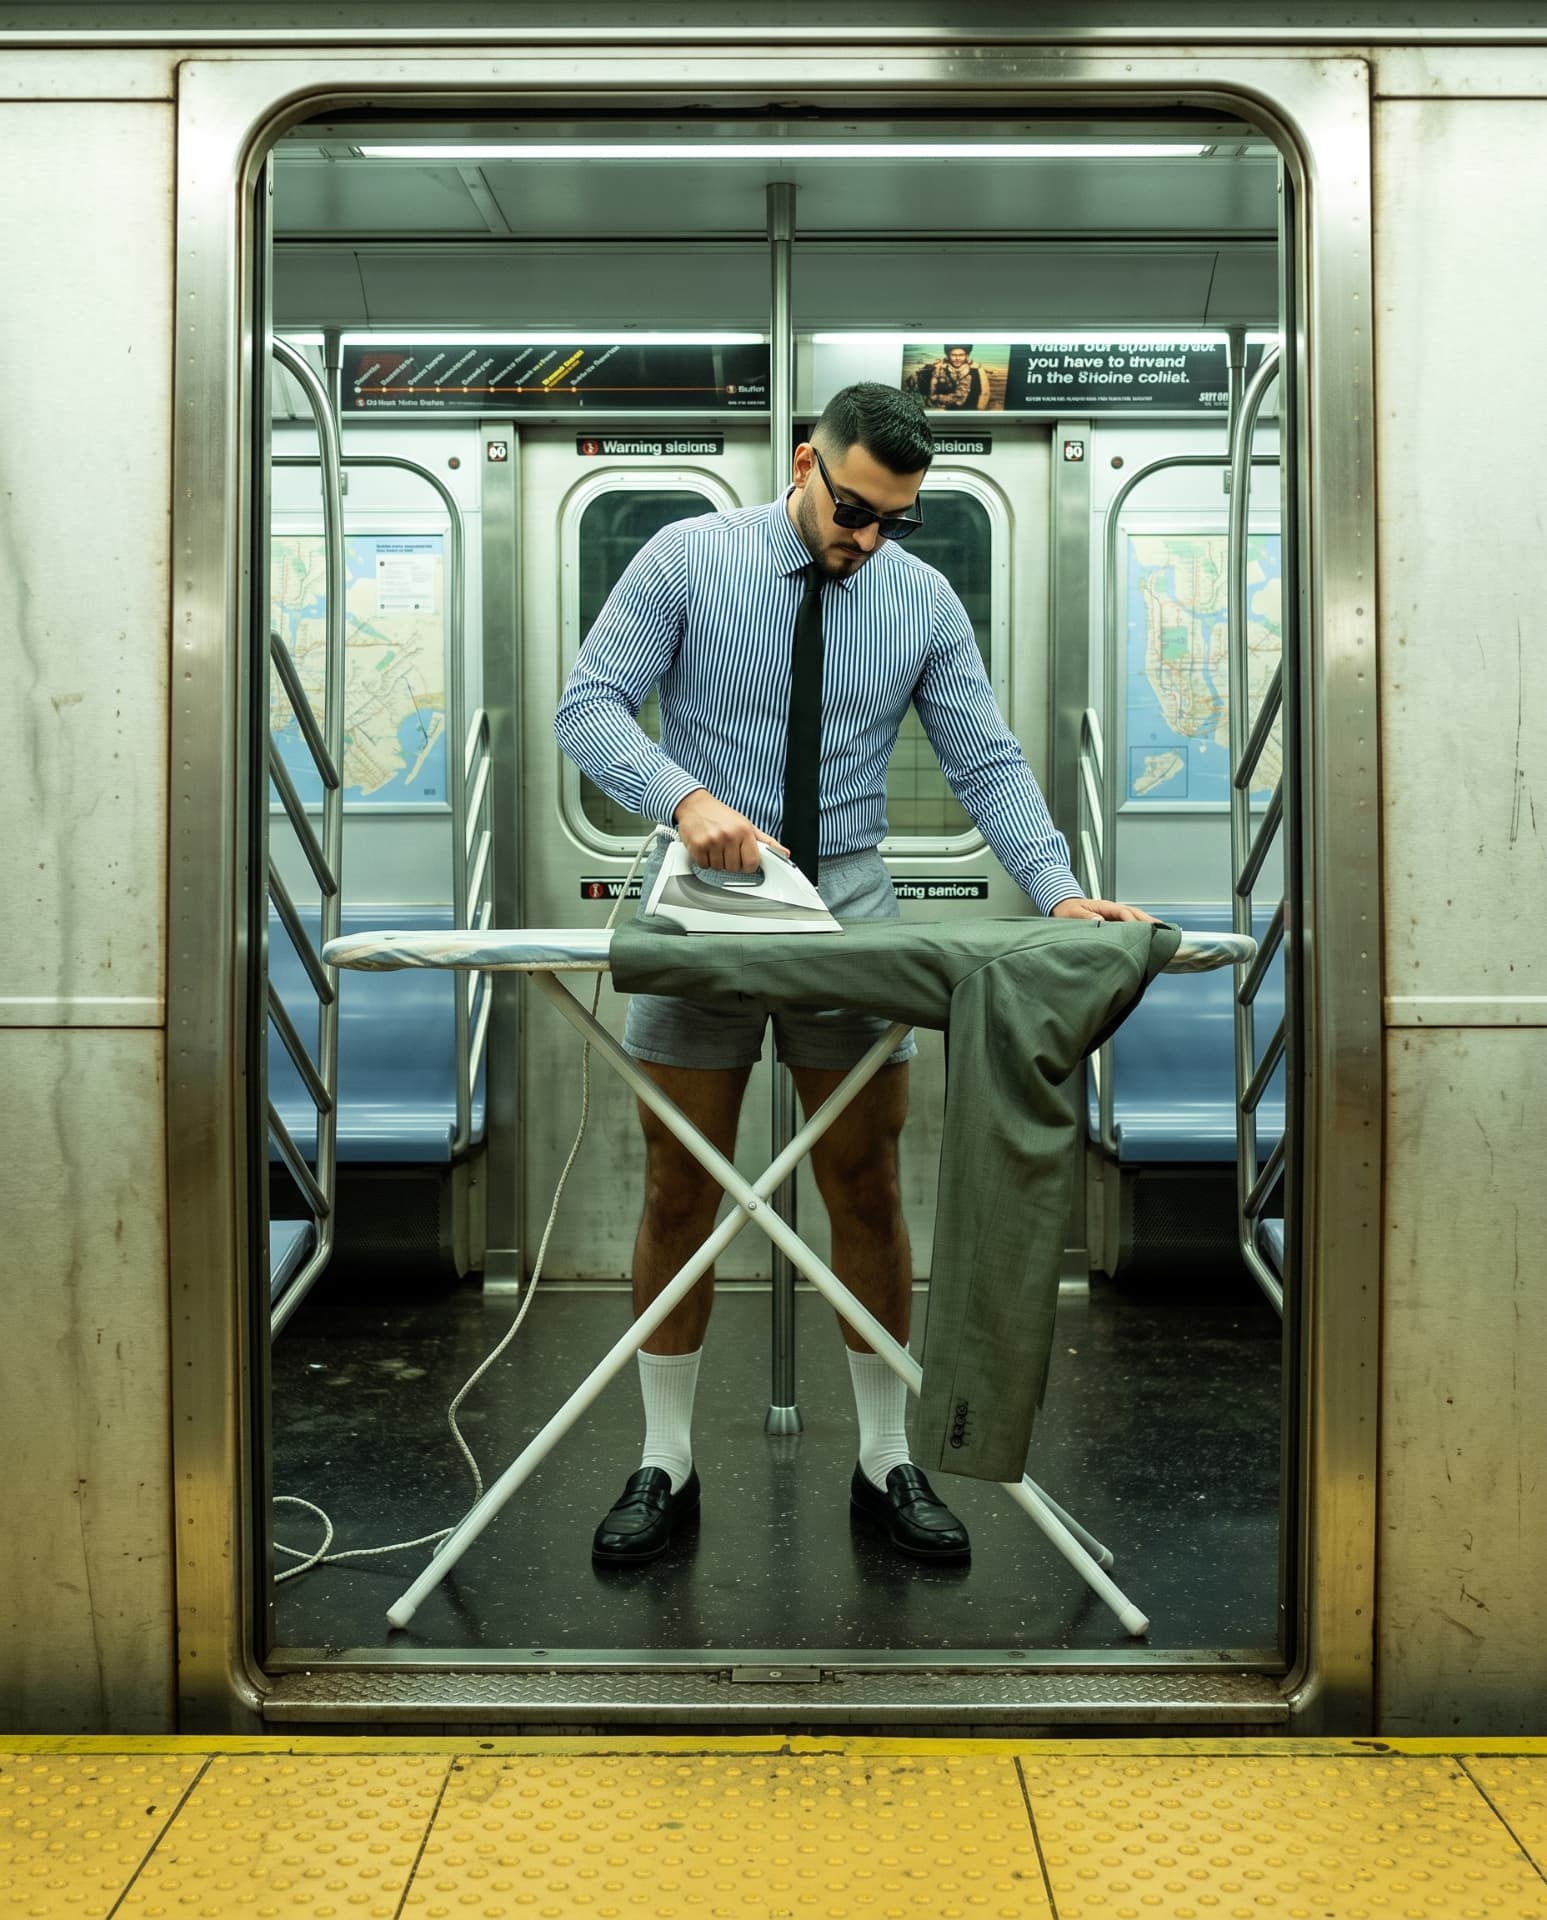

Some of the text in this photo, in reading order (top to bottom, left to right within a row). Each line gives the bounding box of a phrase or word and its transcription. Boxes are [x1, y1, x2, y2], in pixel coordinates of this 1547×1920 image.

[1027, 358, 1059, 370] you
[1063, 355, 1103, 368] have
[1108, 356, 1125, 368] to
[1027, 371, 1042, 384] in
[1047, 371, 1073, 384] the
[602, 440, 662, 456] Warning
